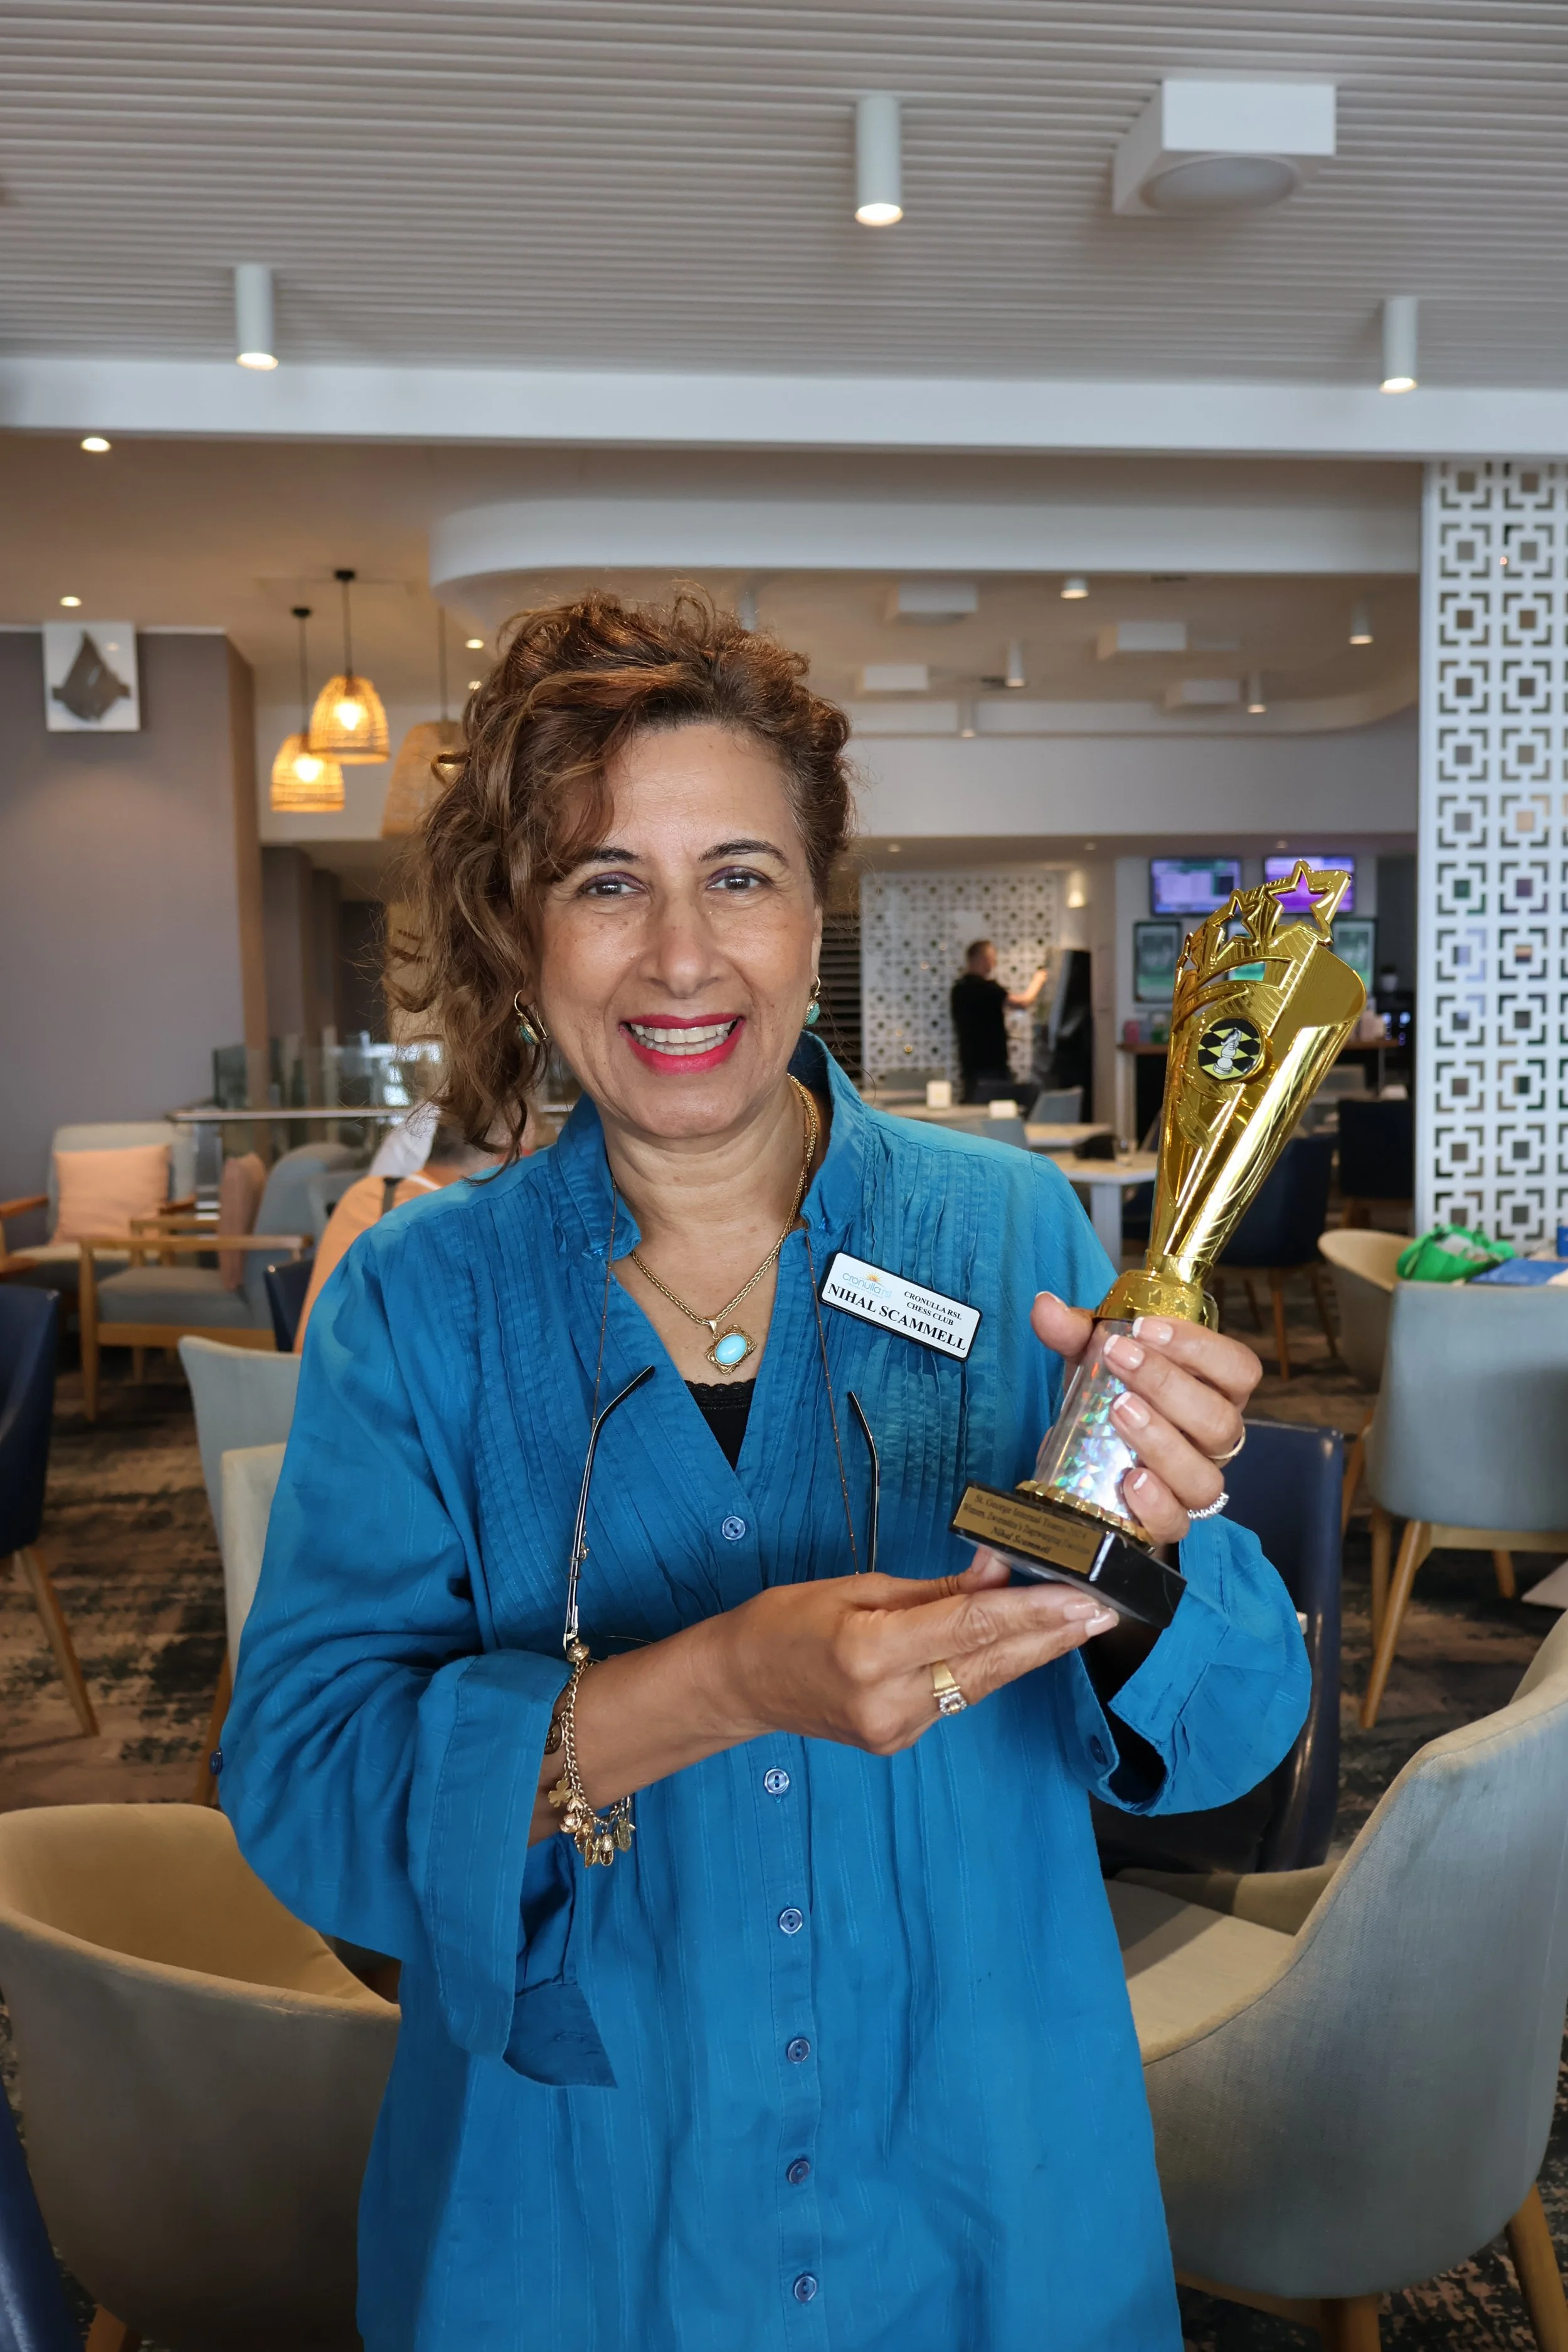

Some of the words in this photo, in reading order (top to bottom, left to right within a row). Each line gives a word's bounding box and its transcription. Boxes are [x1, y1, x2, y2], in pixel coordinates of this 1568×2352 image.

[828, 1283, 877, 1313] NIHAL
[879, 1305, 966, 1350] SCAMMELL
[904, 1291, 946, 1313] CRONULLA
[947, 1308, 963, 1320] RSL
[907, 1301, 932, 1316] CHESS
[933, 1313, 954, 1326] CLUB
